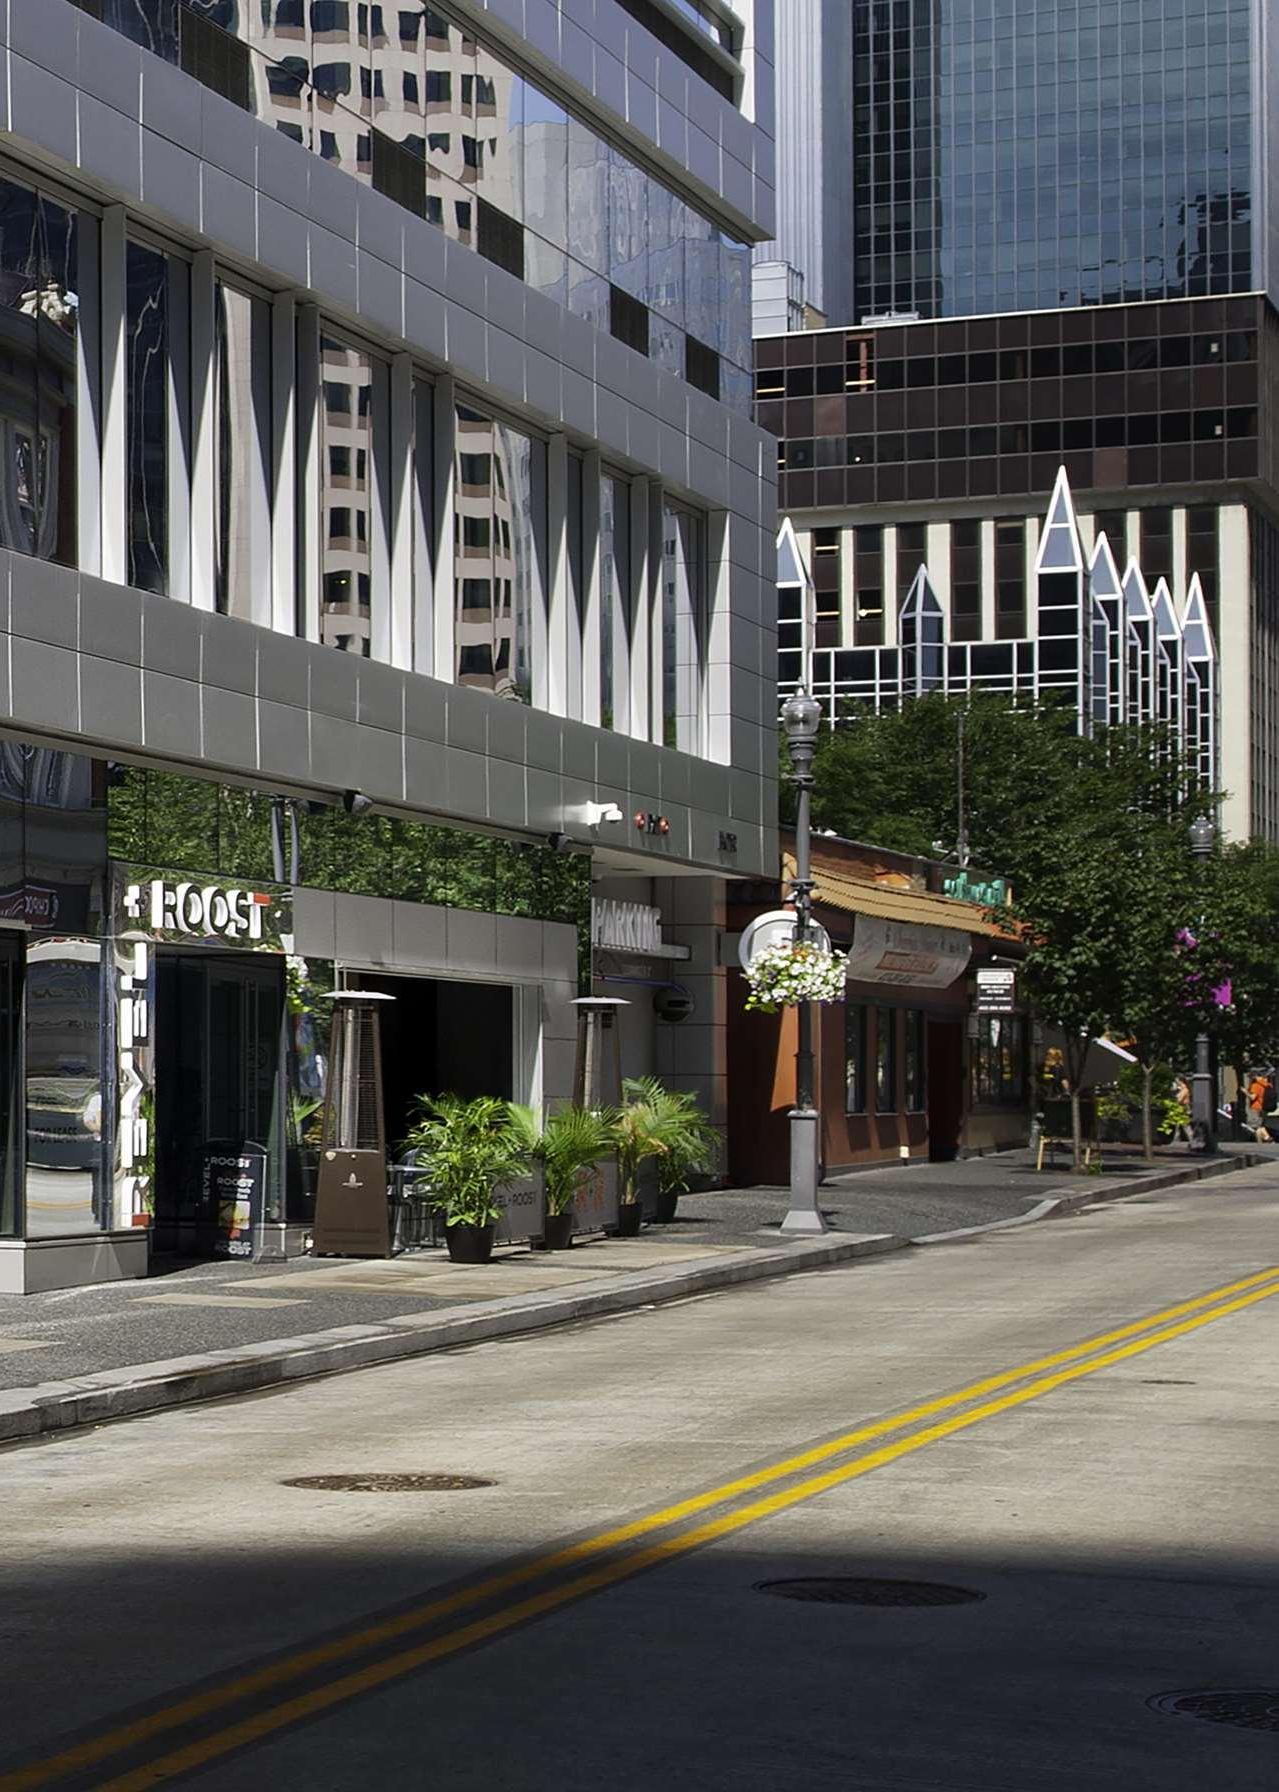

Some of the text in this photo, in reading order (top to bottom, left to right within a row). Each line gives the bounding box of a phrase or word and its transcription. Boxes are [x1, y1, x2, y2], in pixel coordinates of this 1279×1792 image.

[151, 880, 271, 939] ROOST
[591, 897, 662, 951] PARKING
[210, 1156, 252, 1168] ROOST
